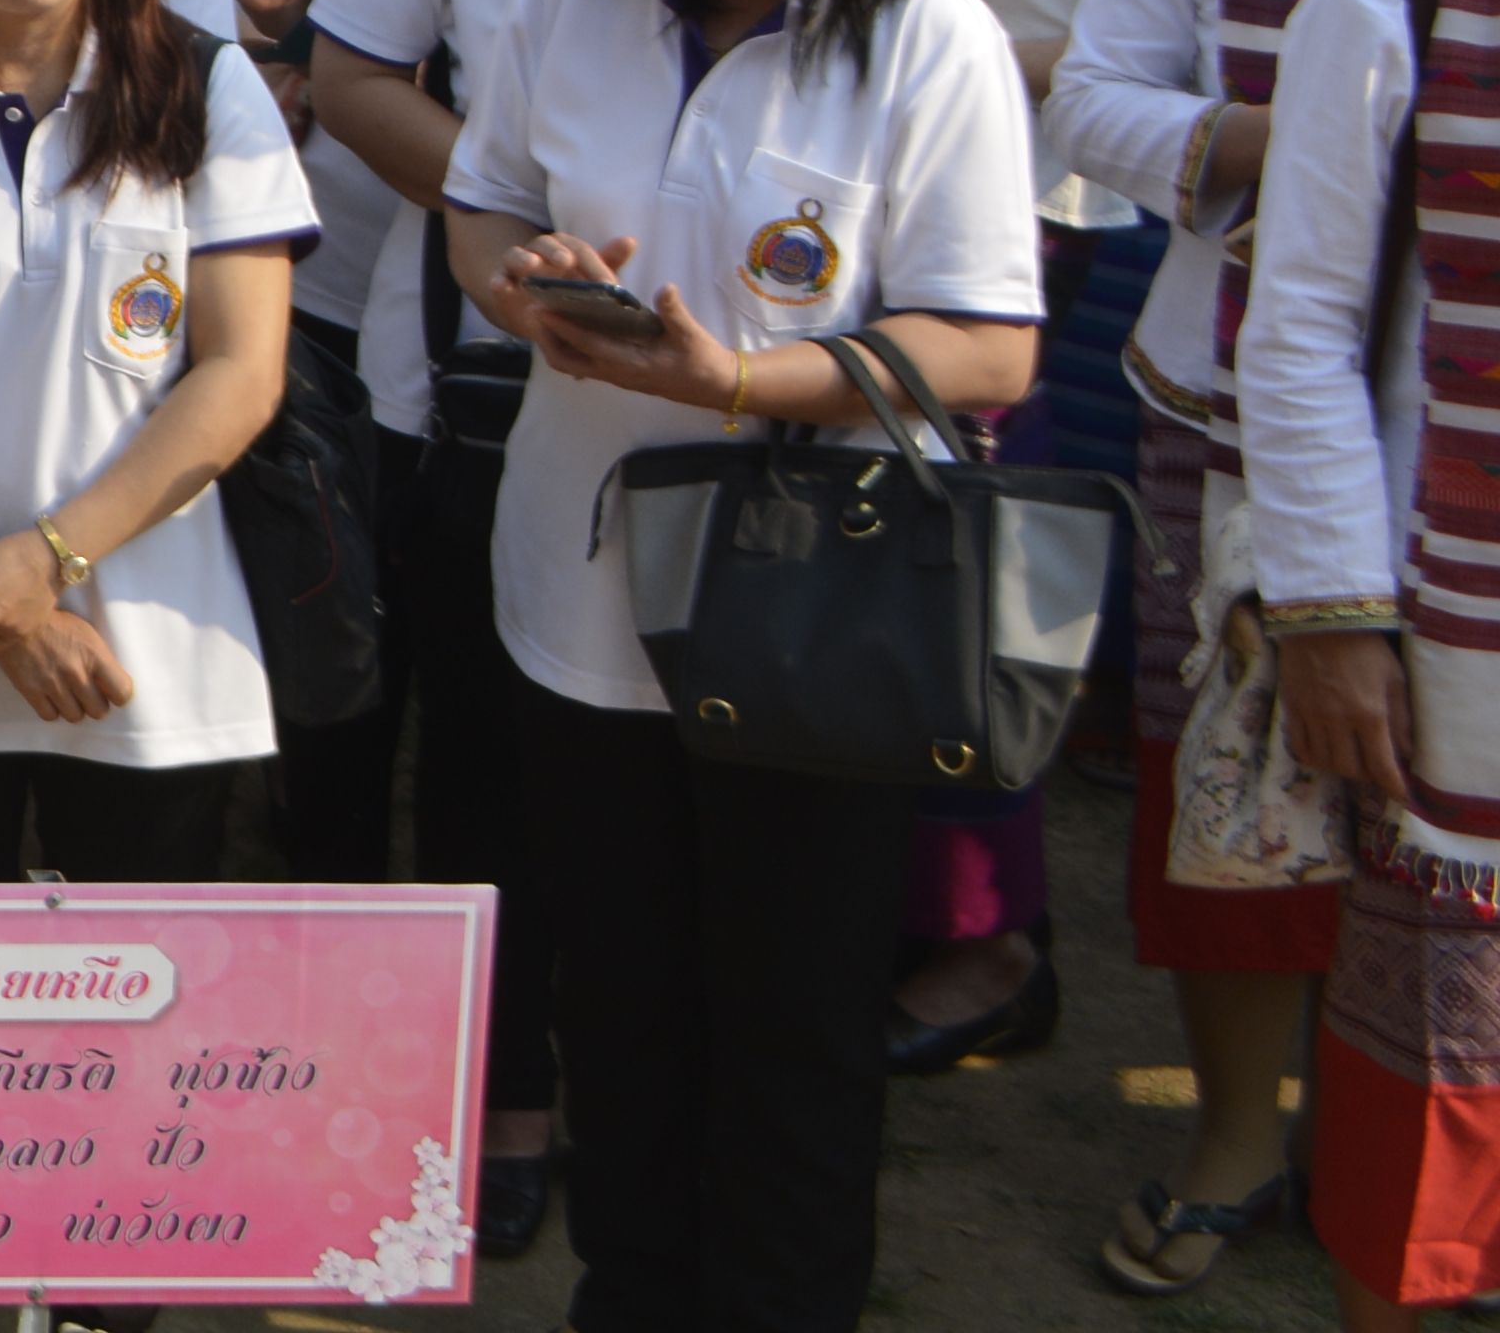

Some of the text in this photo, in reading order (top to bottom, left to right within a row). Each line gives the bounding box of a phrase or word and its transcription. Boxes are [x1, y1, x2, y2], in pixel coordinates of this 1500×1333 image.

[165, 1045, 329, 1109] ทุ่งช้าง
[144, 1113, 206, 1172] ปัว
[62, 1188, 250, 1249] ท่าวังผา
